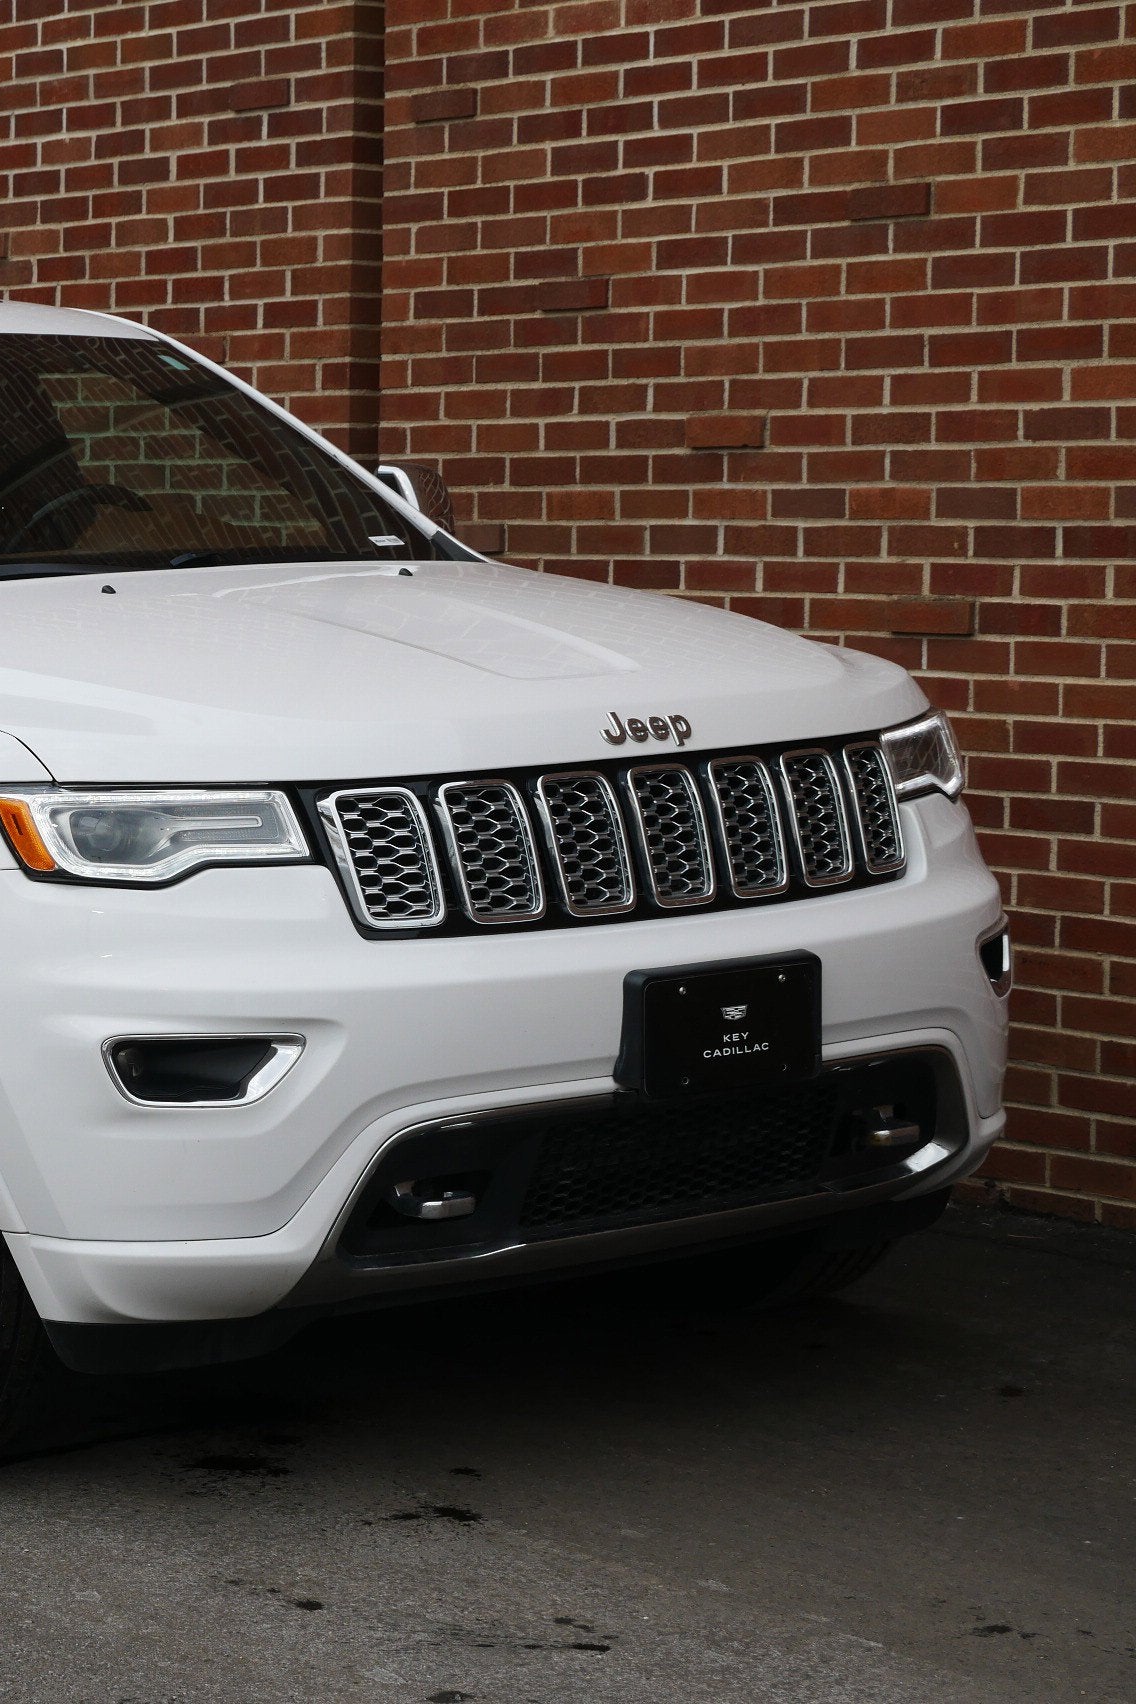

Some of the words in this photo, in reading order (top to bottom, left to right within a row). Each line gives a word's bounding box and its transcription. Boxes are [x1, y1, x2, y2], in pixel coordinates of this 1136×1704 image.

[599, 711, 692, 746] Jeep
[723, 1031, 749, 1043] KEY
[702, 1042, 770, 1059] CADILLAC
